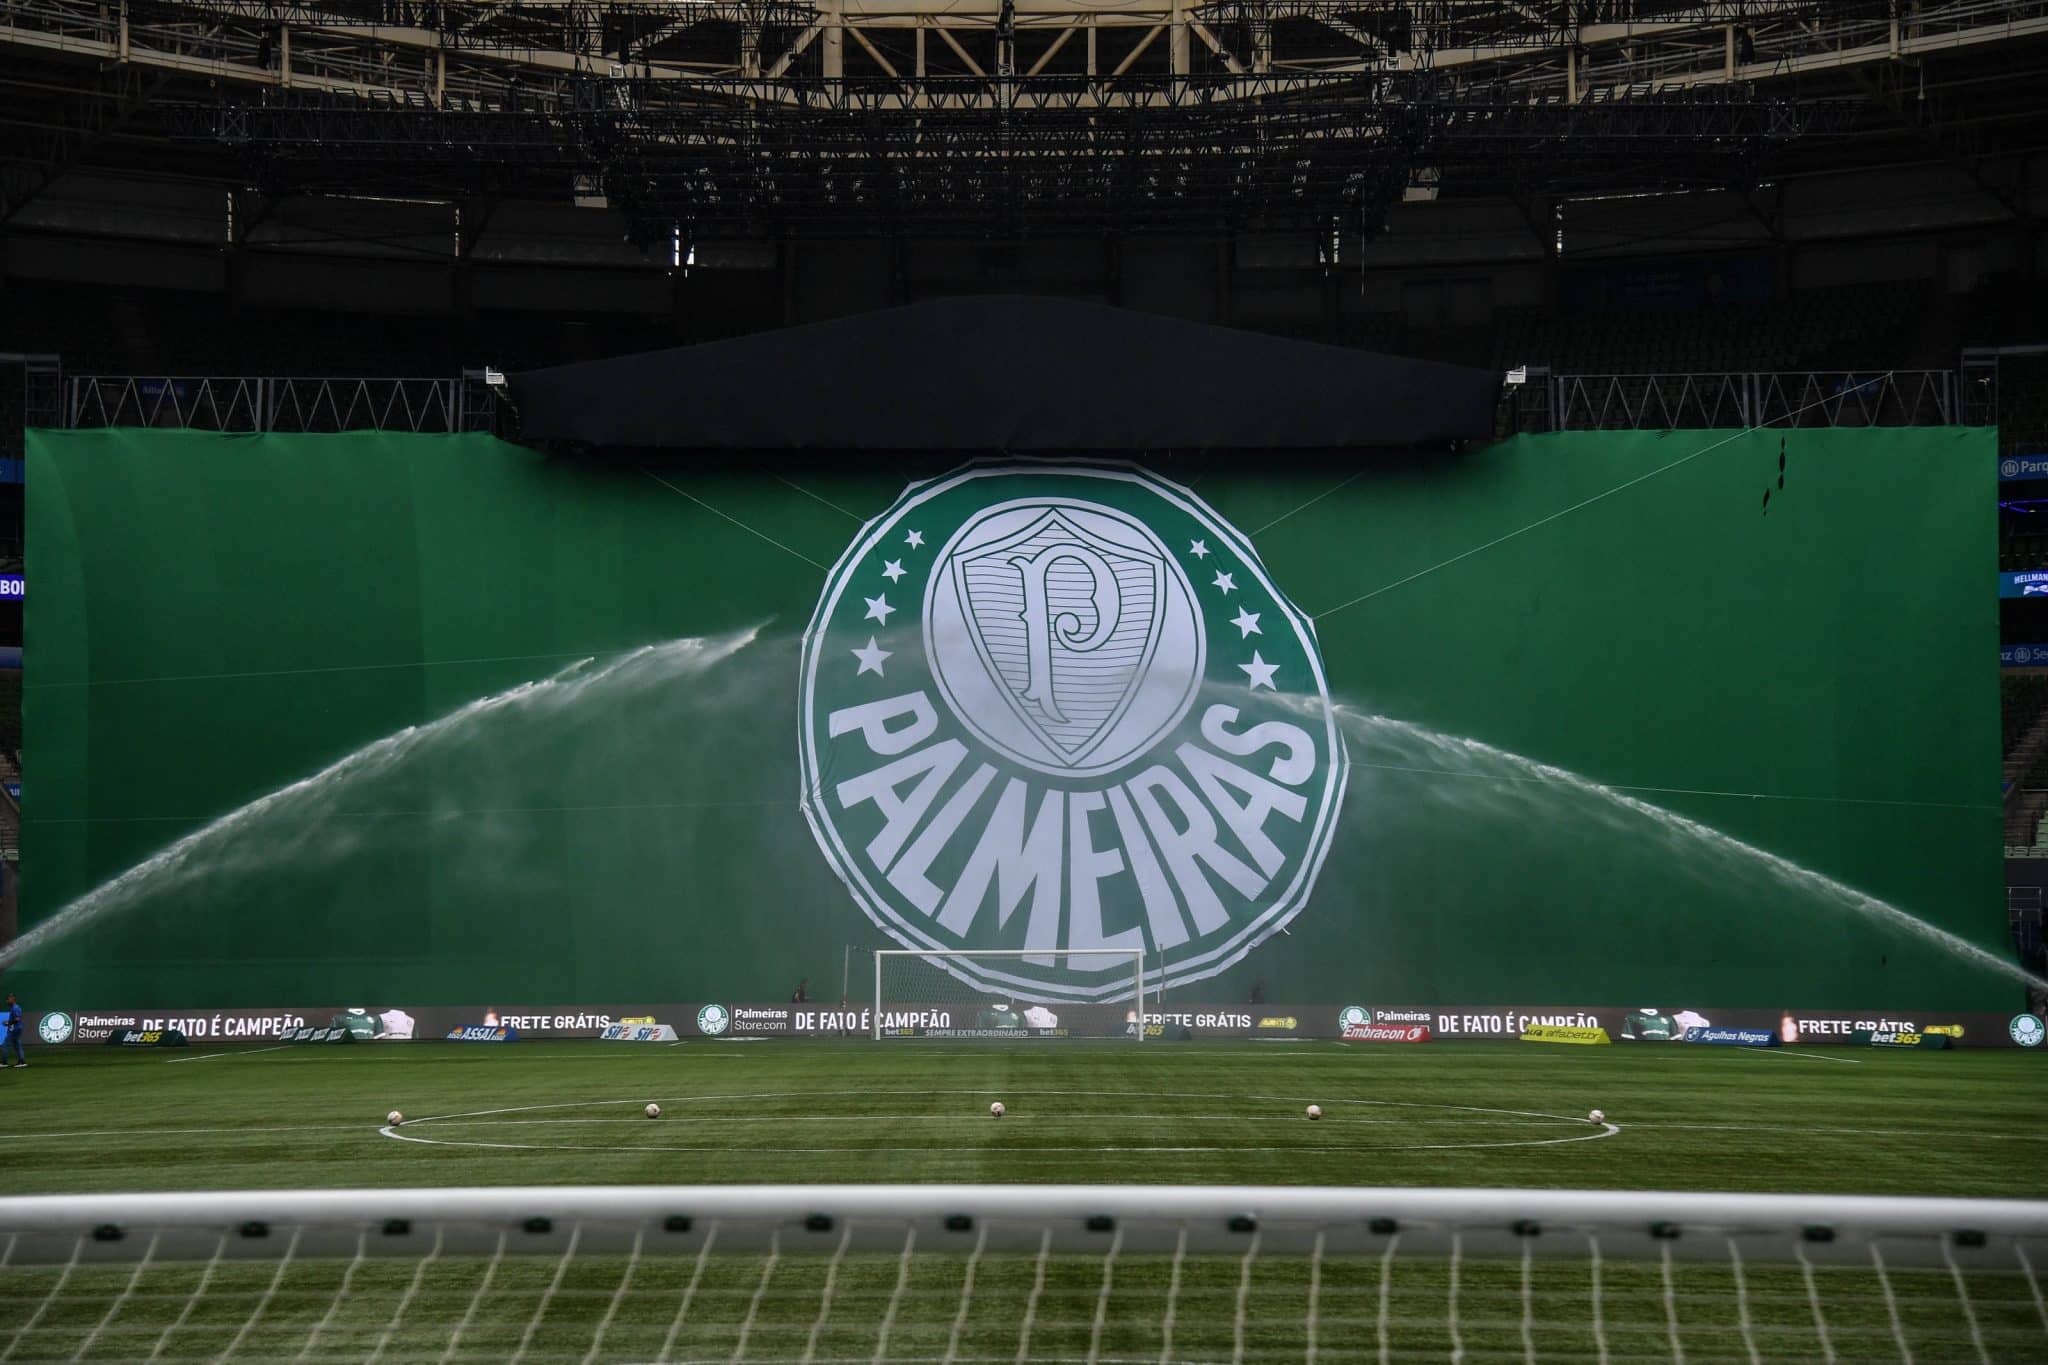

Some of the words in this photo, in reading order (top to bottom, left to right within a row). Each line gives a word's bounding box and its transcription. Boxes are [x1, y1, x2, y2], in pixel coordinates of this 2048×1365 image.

[829, 691, 1316, 971] PALMEIRAS
[79, 1016, 135, 1026] Palmeiras
[501, 1015, 551, 1029] FRETE
[554, 1012, 610, 1029] GRÁTIS
[734, 1008, 788, 1019] Palmeiras
[795, 1012, 815, 1030] DE
[819, 1012, 856, 1030] FATO
[861, 1008, 870, 1030] É
[1143, 1013, 1193, 1028] FRETE
[1196, 1011, 1251, 1028] GRÁTIS
[1376, 1010, 1431, 1021] Palmeiras
[168, 1018, 207, 1037] FATO
[211, 1014, 221, 1036] É
[225, 1014, 304, 1036] CAMPEÃO
[734, 1020, 787, 1031] Store.com
[1439, 1015, 1459, 1033] DE
[1463, 1015, 1500, 1033] FATO
[1506, 1011, 1516, 1033] É
[1800, 1020, 1851, 1034] FRETE
[1855, 1018, 1915, 1033] GRÁTIS
[122, 1030, 162, 1043] bet365
[1343, 1024, 1404, 1040] Embracon
[1702, 1030, 1737, 1041] Agulhas
[1738, 1031, 1769, 1043] Negras
[1870, 1031, 1922, 1045] bet365
